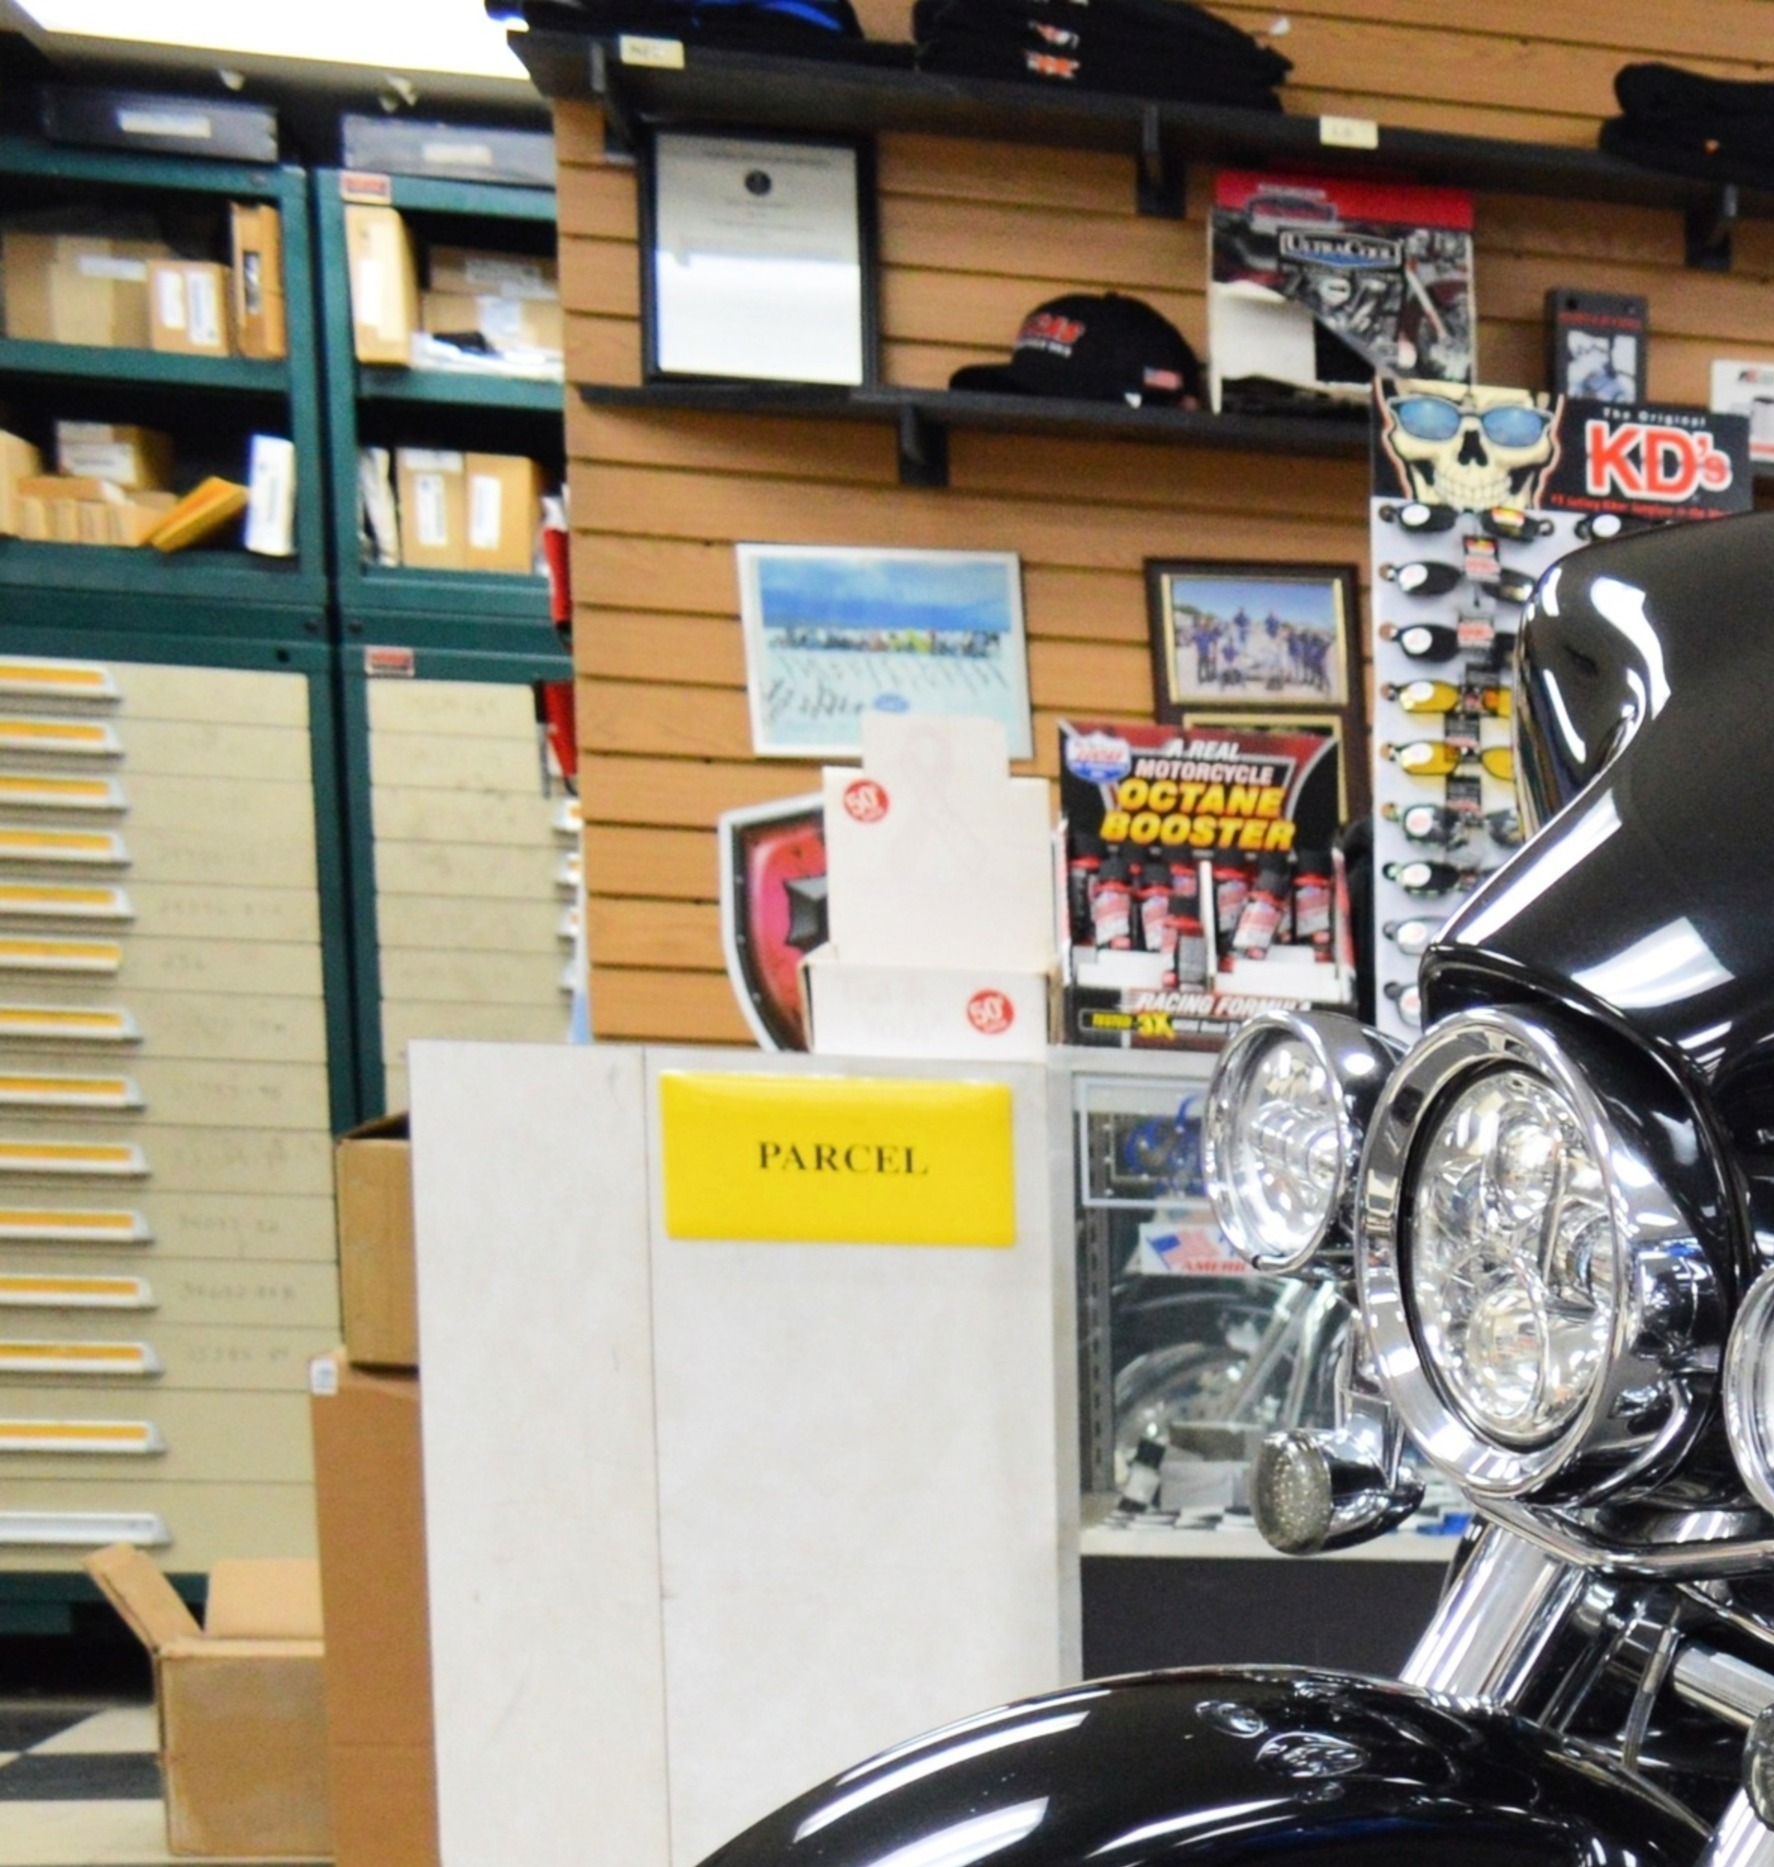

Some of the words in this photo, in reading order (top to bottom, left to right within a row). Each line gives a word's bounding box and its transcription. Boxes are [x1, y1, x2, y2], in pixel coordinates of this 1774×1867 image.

[1603, 407, 1631, 420] The
[1637, 411, 1707, 427] Original
[1586, 419, 1733, 502] KD's
[1162, 738, 1185, 756] A
[1188, 740, 1240, 762] REAL
[1135, 758, 1274, 785] MOTORCYCLE
[1116, 778, 1287, 819] OCTANE
[1100, 810, 1297, 852] BOOSTER
[1138, 991, 1215, 1015] RACING
[757, 1140, 929, 1176] PARCEL
